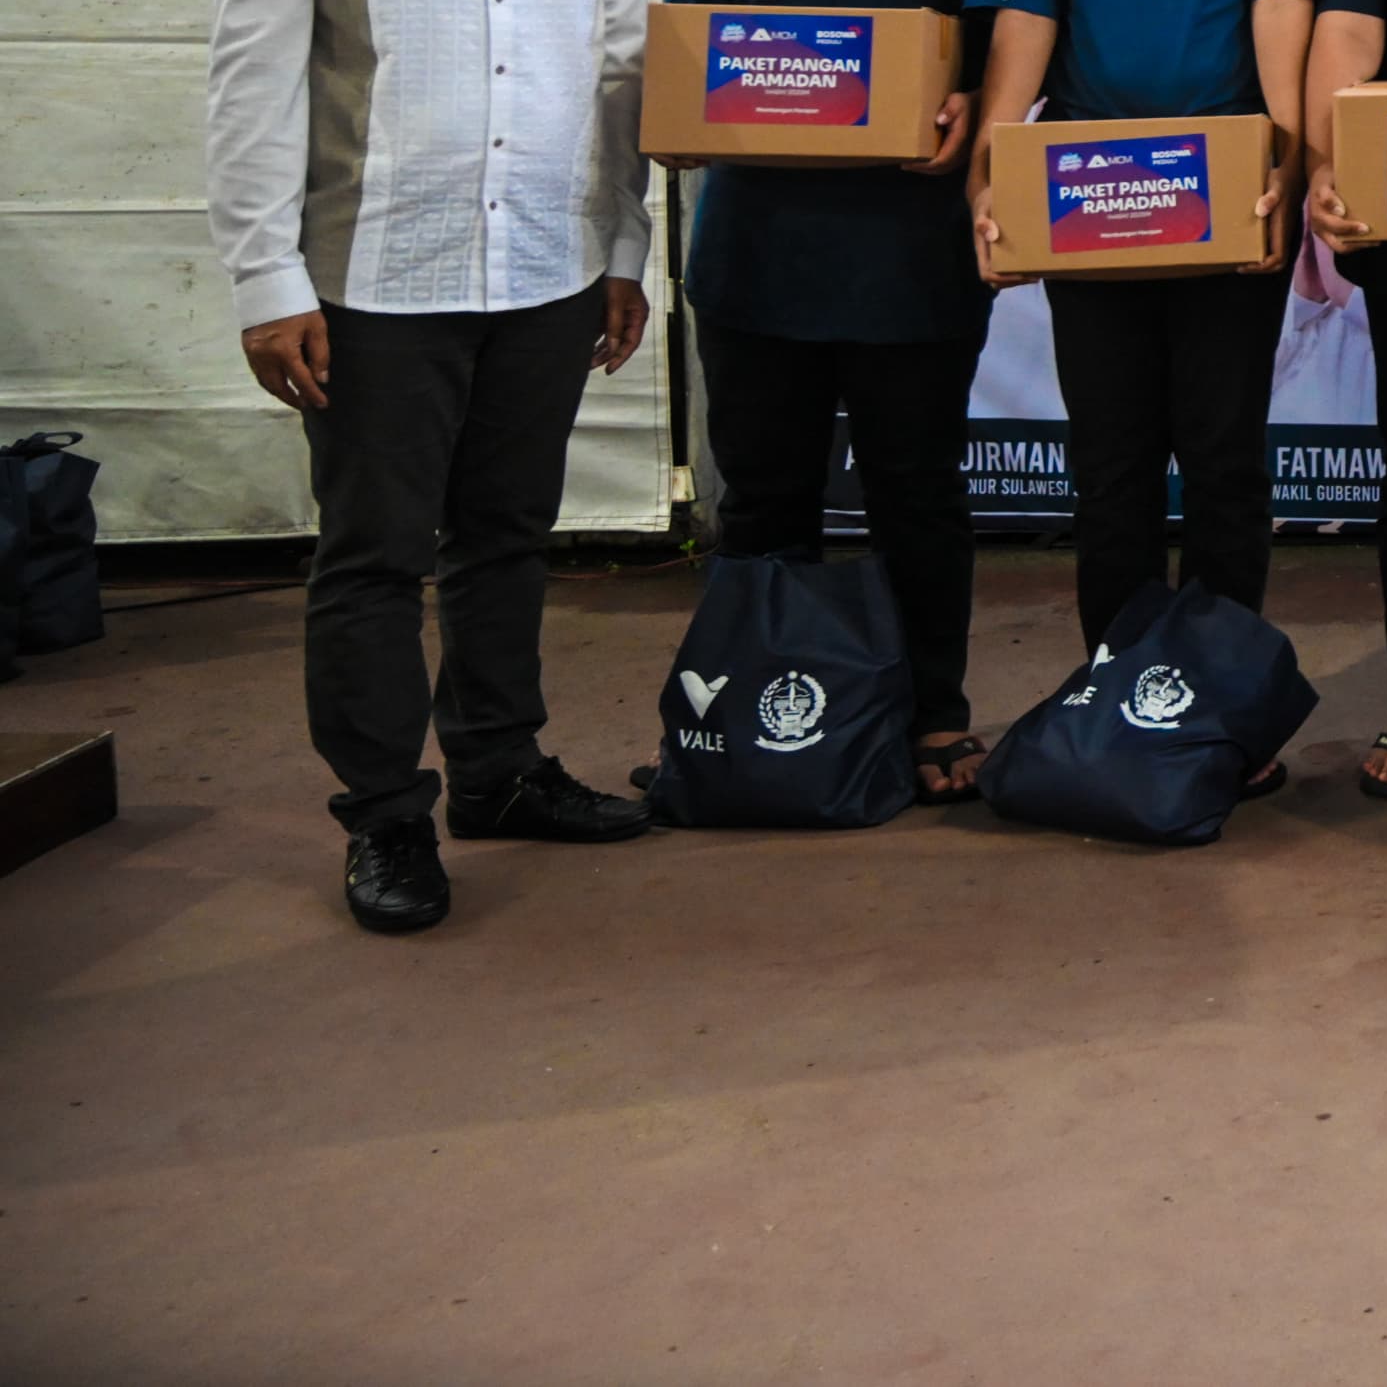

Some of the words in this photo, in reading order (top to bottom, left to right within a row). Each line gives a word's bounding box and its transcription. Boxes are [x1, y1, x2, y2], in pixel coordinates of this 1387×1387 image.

[718, 56, 775, 70] PAKET
[780, 58, 859, 71] PANGAN
[741, 73, 836, 86] RAMADAN
[1058, 182, 1115, 198] PAKET
[1118, 176, 1197, 193] PANGAN
[1082, 193, 1176, 213] RAMADAN
[1275, 445, 1387, 480] FATMAW
[1000, 477, 1069, 497] SULAWESI
[1315, 485, 1381, 504] GUBERNU
[679, 728, 723, 751] VALE
